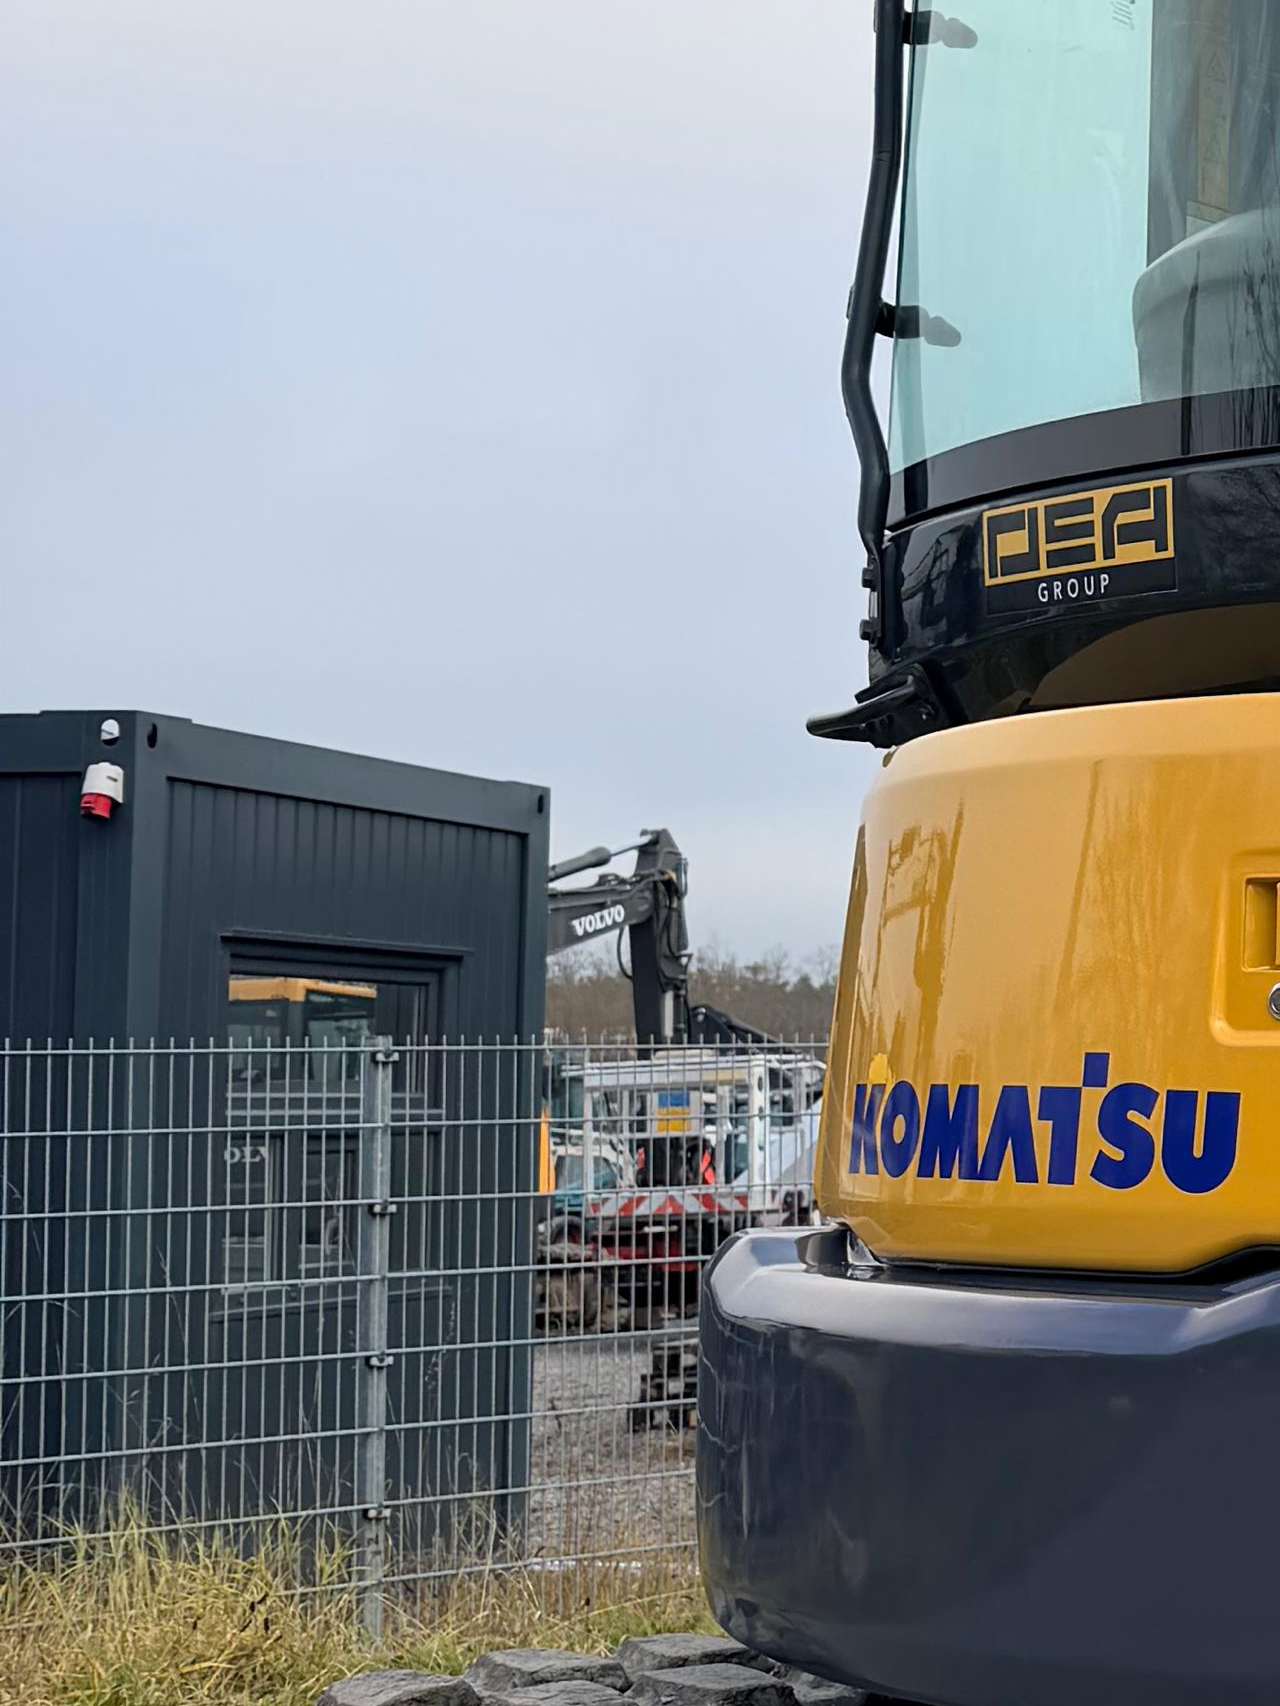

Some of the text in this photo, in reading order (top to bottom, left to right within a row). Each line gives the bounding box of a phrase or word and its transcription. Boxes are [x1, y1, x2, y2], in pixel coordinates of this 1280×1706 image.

[1038, 574, 1110, 602] GROUP
[571, 904, 625, 936] VOLVO
[849, 1052, 1241, 1194] KOMATSU
